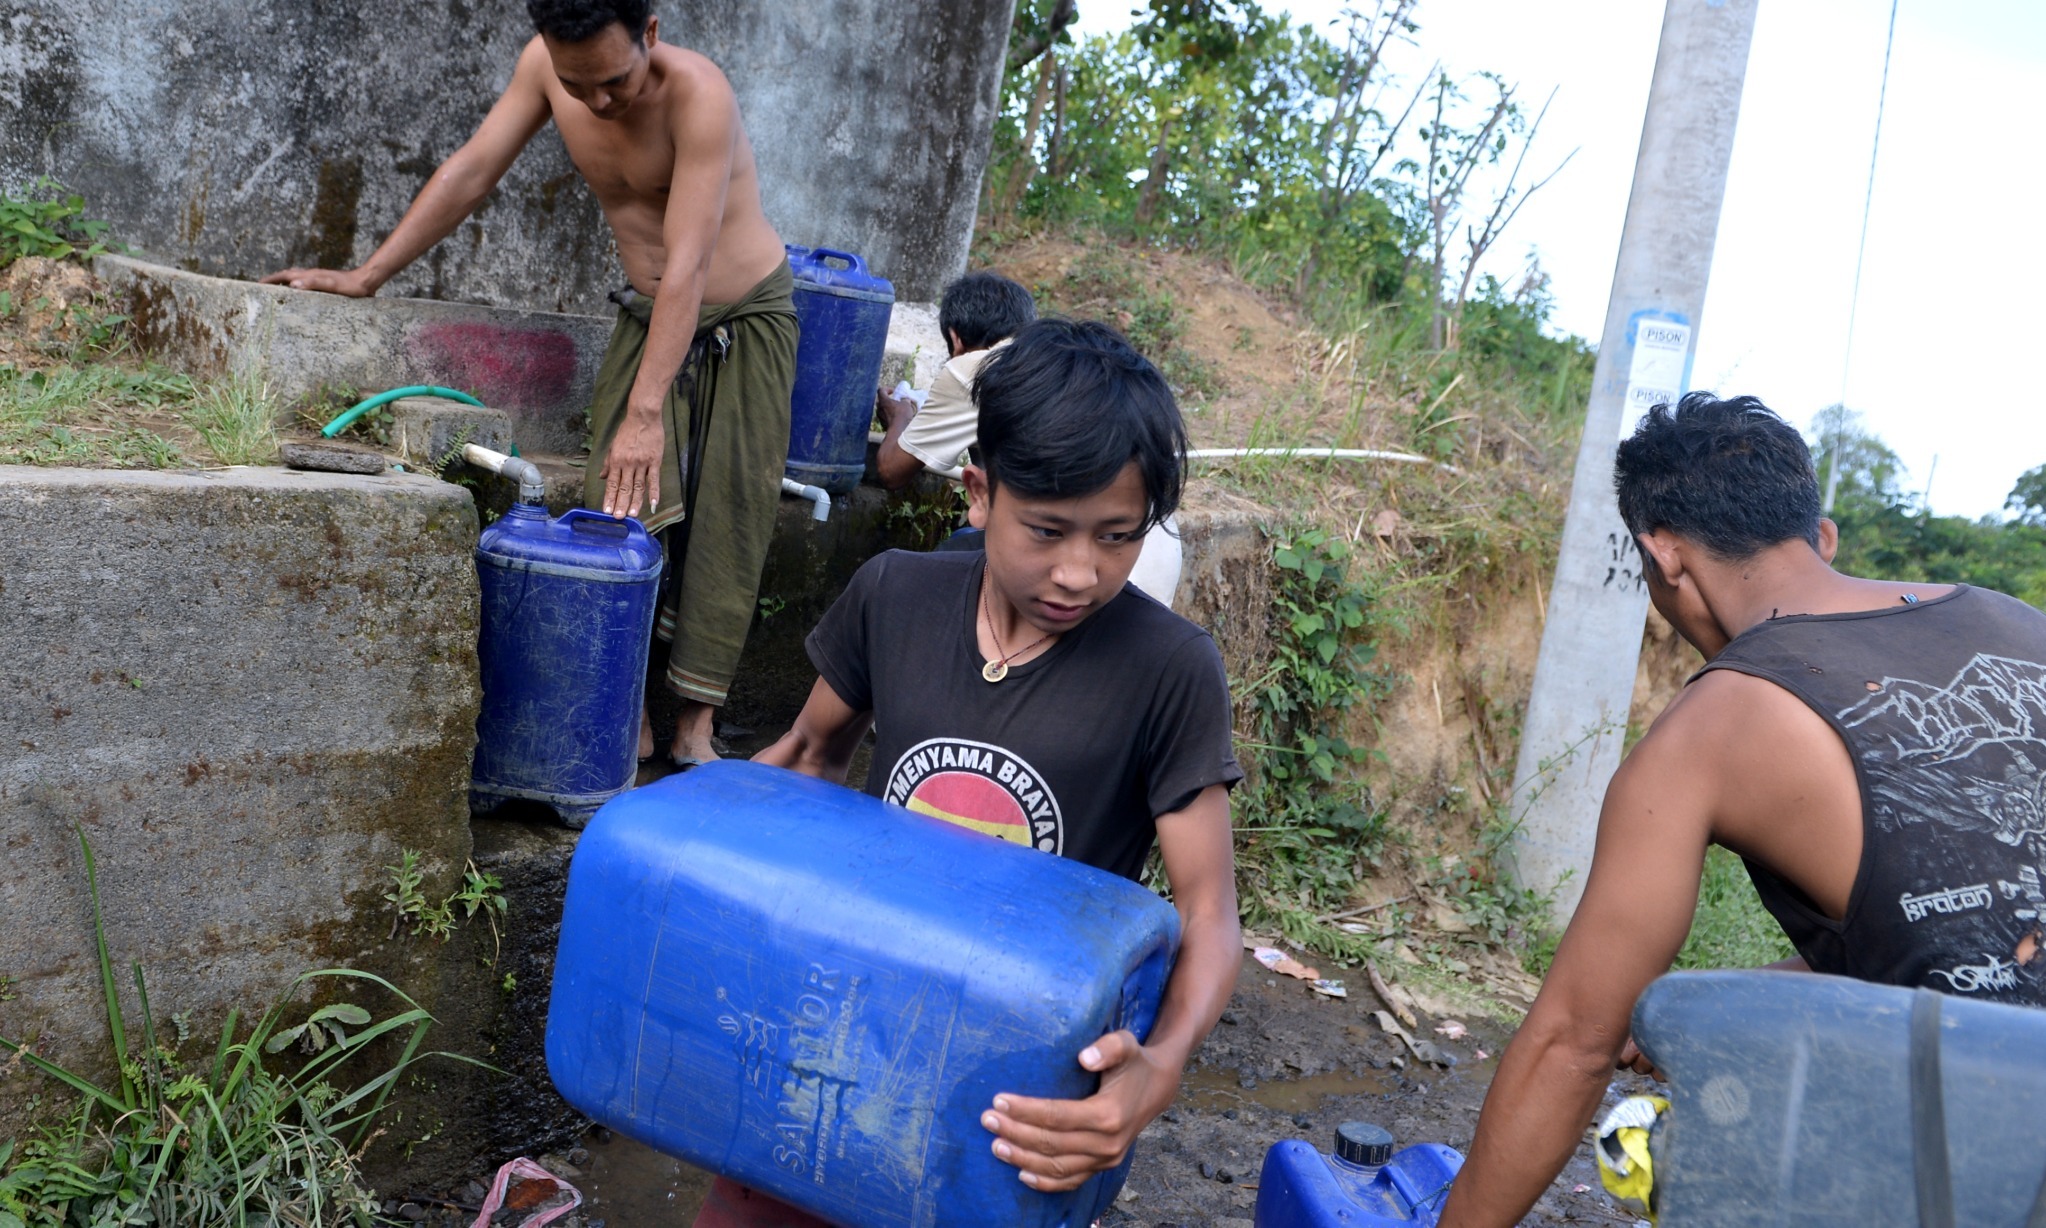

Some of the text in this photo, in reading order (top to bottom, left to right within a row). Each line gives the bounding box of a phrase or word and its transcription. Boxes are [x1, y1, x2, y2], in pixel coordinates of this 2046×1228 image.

[1647, 328, 1682, 342] PISON
[1636, 389, 1671, 403] PISON
[893, 746, 1056, 838] MENYAMA BRAYA
